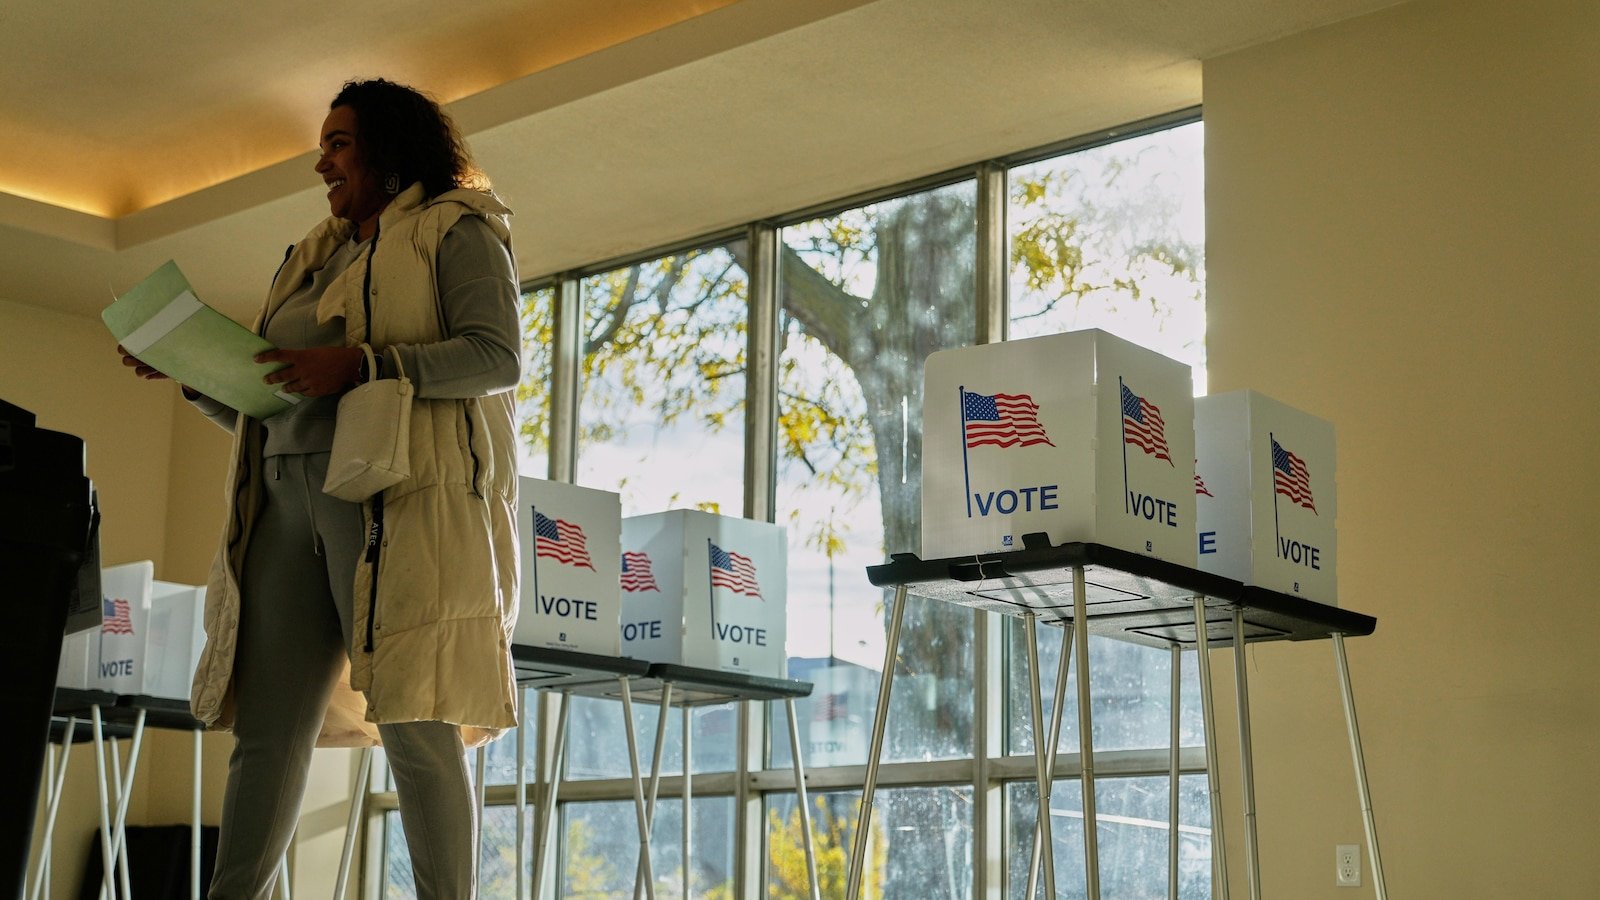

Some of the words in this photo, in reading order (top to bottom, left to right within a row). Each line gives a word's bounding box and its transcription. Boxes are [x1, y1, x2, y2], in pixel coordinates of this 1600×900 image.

[974, 484, 1059, 517] VOTE
[1129, 491, 1177, 528] VOTE
[369, 522, 379, 546] AVEC
[1280, 536, 1321, 570] VOTE
[541, 596, 597, 620] VOTE
[621, 620, 661, 641] OTE
[716, 623, 767, 647] VOTE
[101, 659, 133, 678] VOTE
